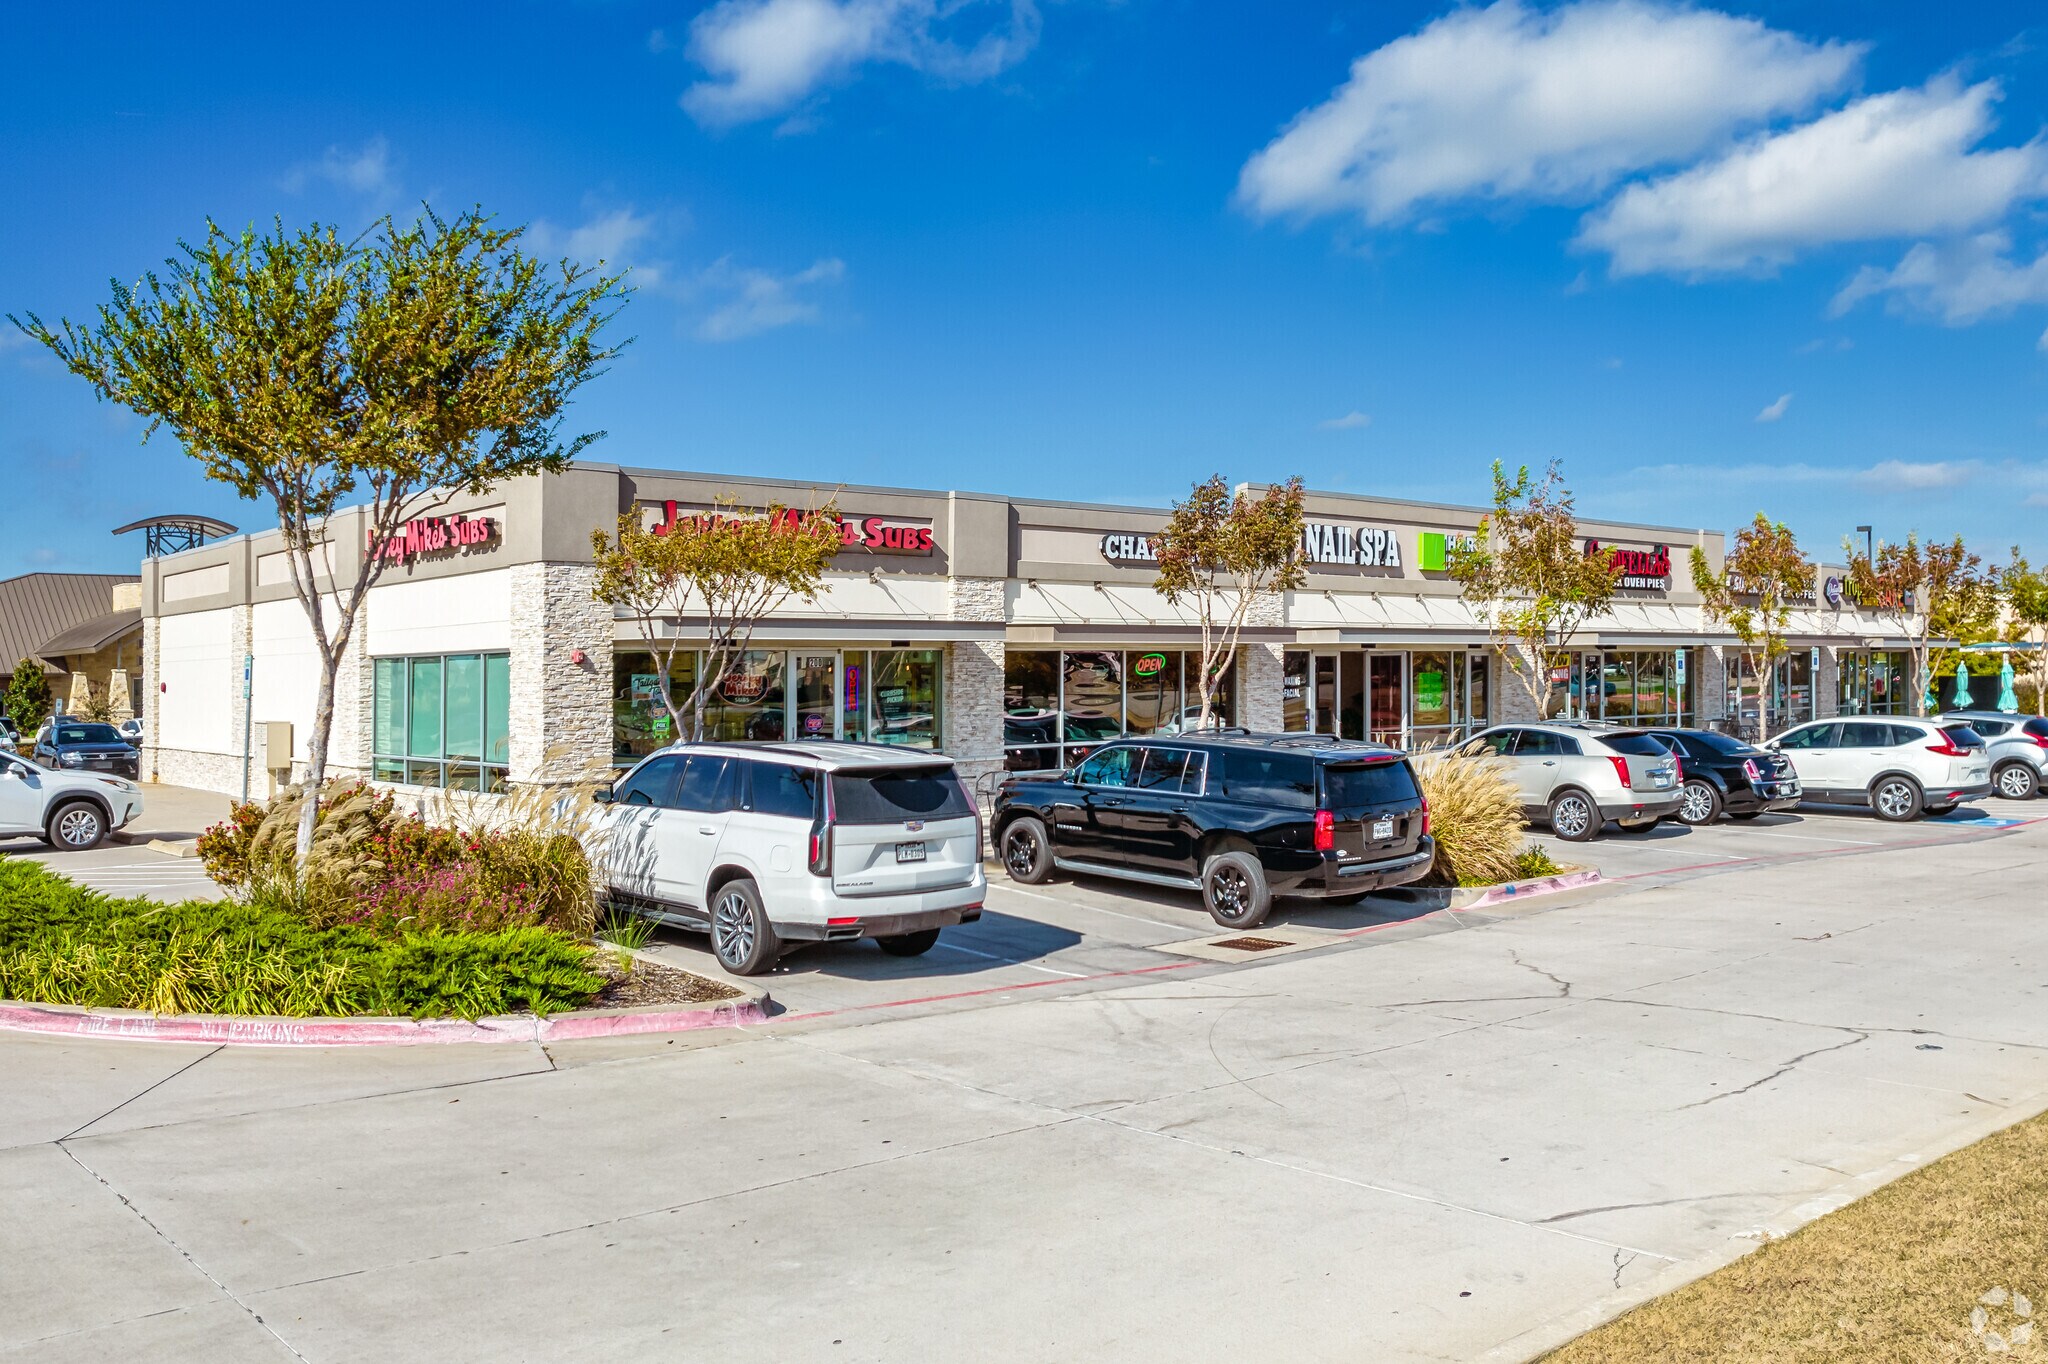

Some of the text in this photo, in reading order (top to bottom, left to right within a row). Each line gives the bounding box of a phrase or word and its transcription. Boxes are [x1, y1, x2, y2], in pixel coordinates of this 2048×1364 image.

[1304, 523, 1355, 564] NAIL
[1360, 527, 1400, 567] SPA
[1624, 577, 1646, 588] OVEN
[1647, 578, 1665, 589] PIES
[1138, 658, 1162, 671] OPEN
